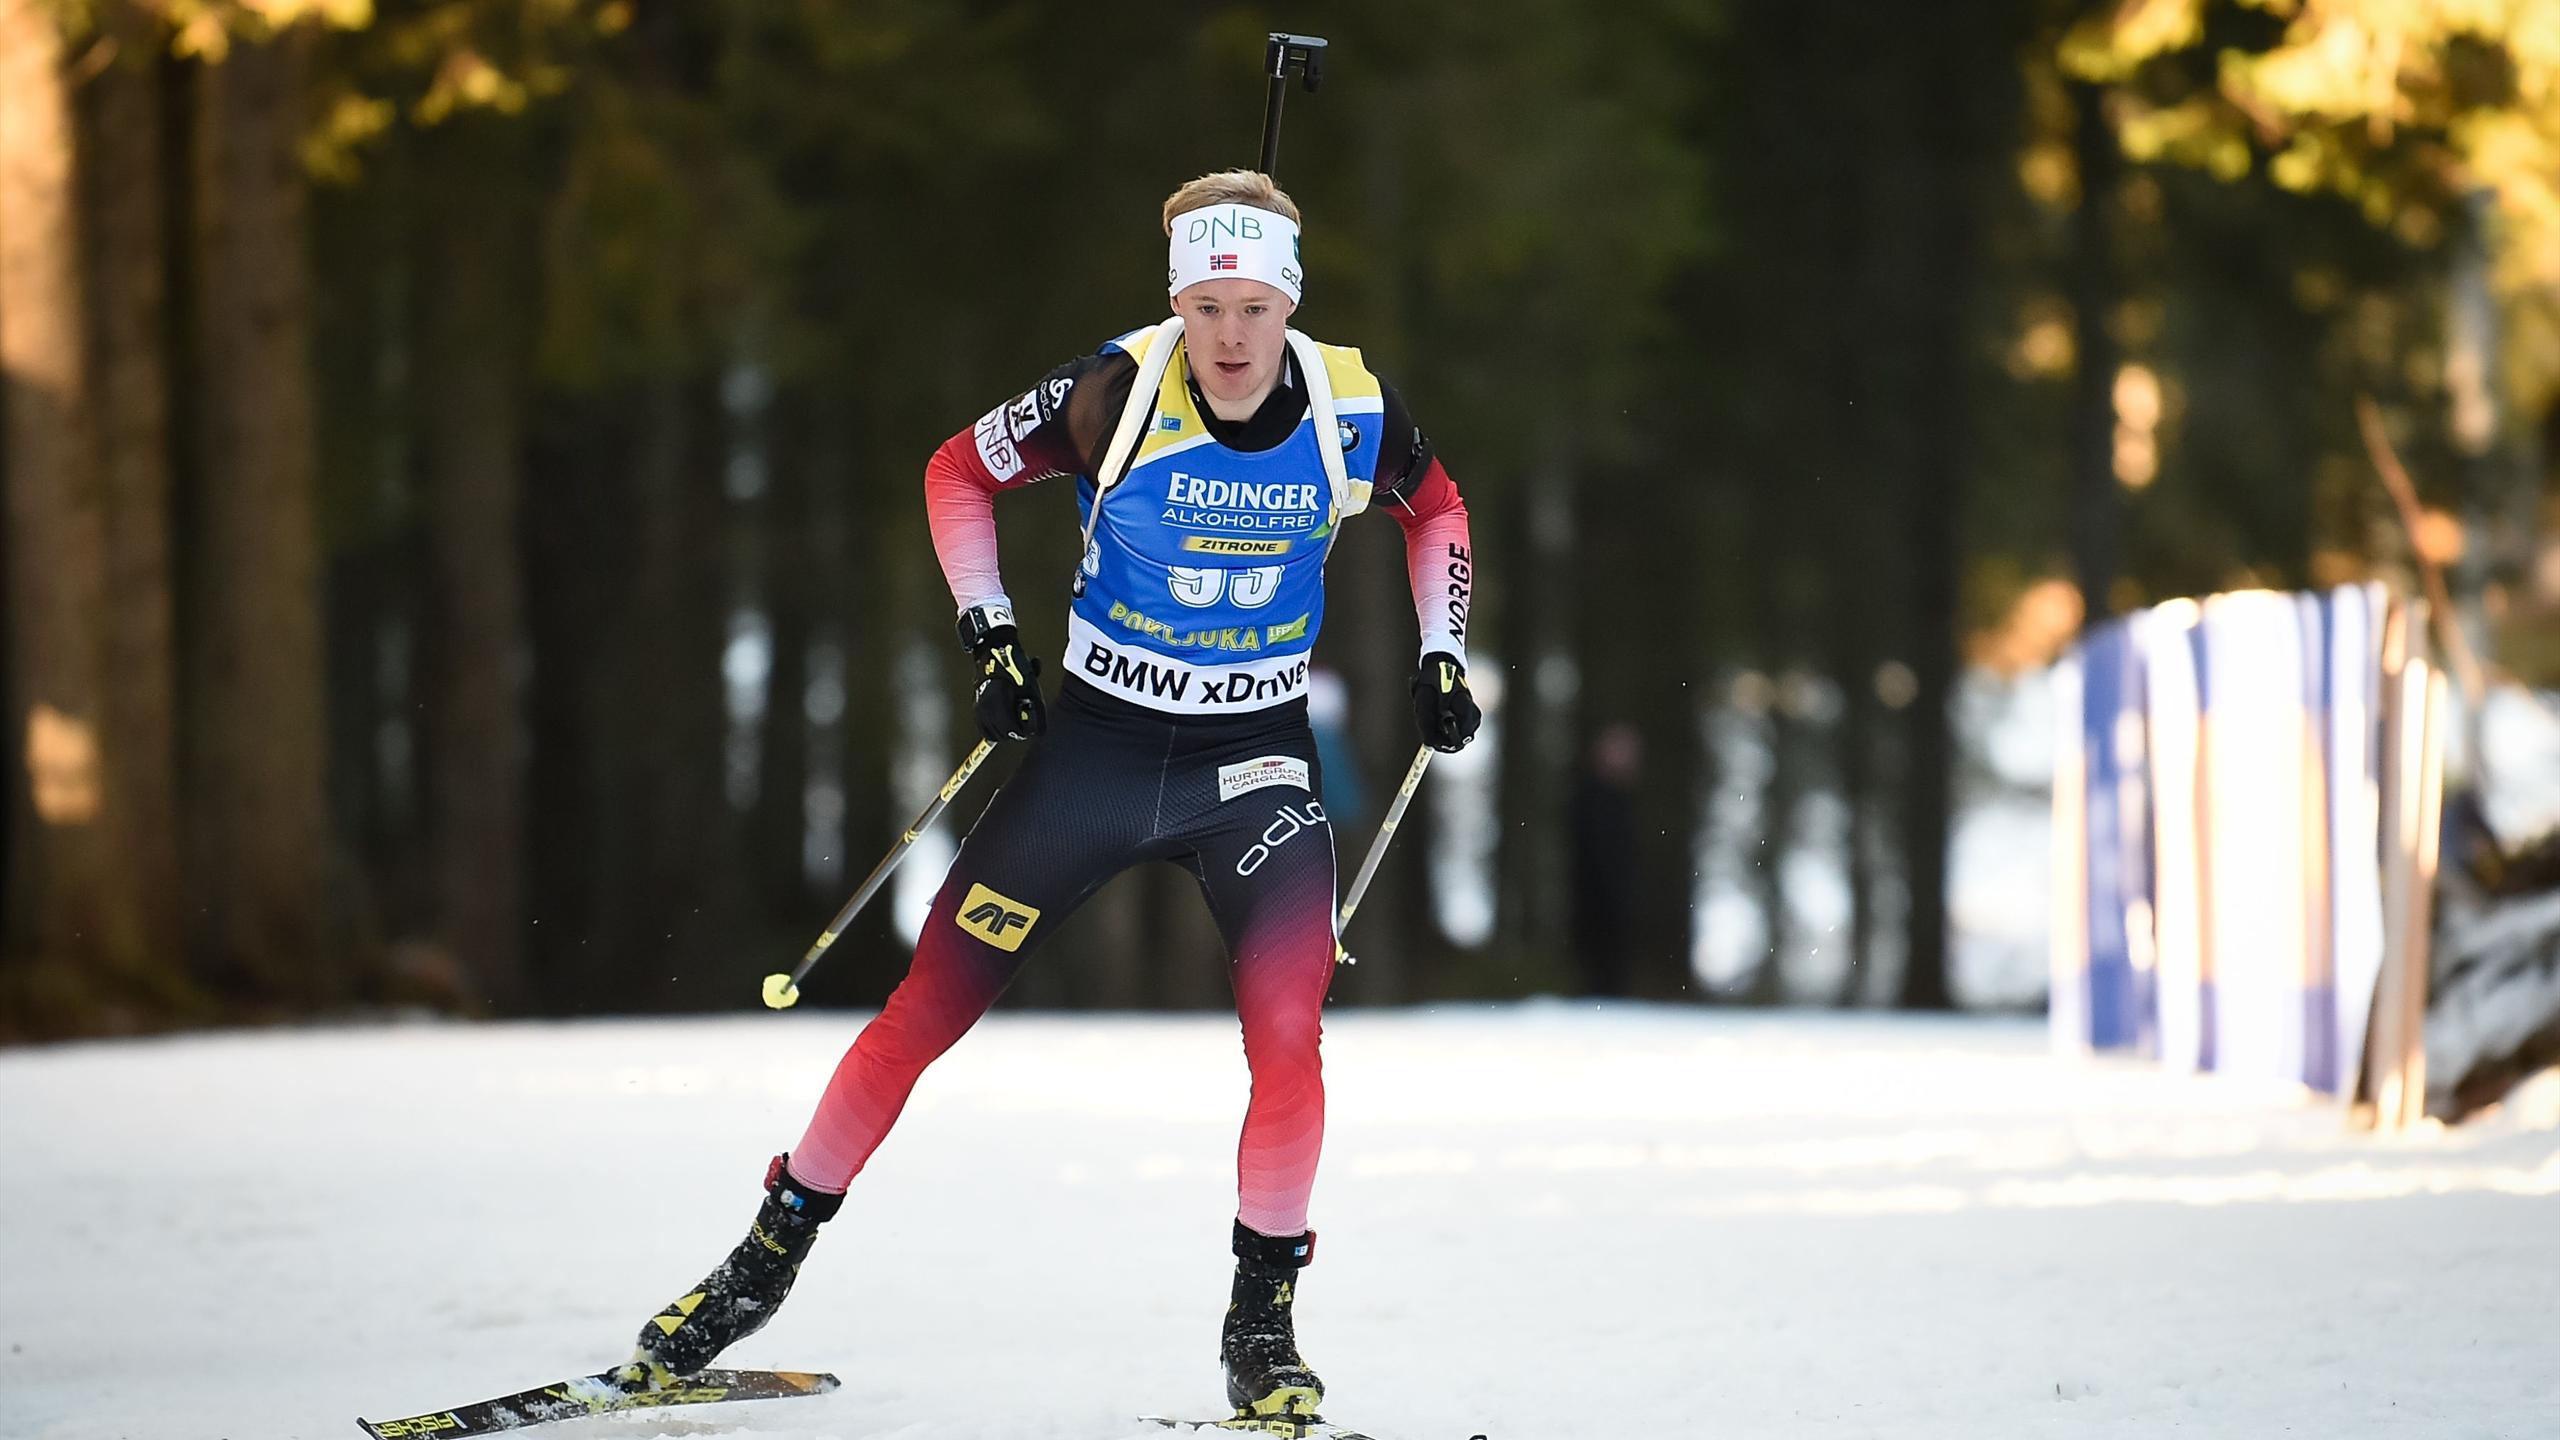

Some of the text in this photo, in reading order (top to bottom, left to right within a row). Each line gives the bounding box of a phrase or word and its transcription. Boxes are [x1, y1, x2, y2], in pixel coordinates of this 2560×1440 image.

[1189, 208, 1263, 249] DNB
[1167, 471, 1320, 511] ERDINGER
[1161, 508, 1315, 529] ALKOHOLFREI
[1199, 538, 1279, 553] ZITRONE
[1448, 542, 1471, 647] NORGE
[1108, 599, 1261, 652] POKLJUKA
[1084, 641, 1307, 705] BMW xDrive
[1236, 800, 1327, 877] odlo
